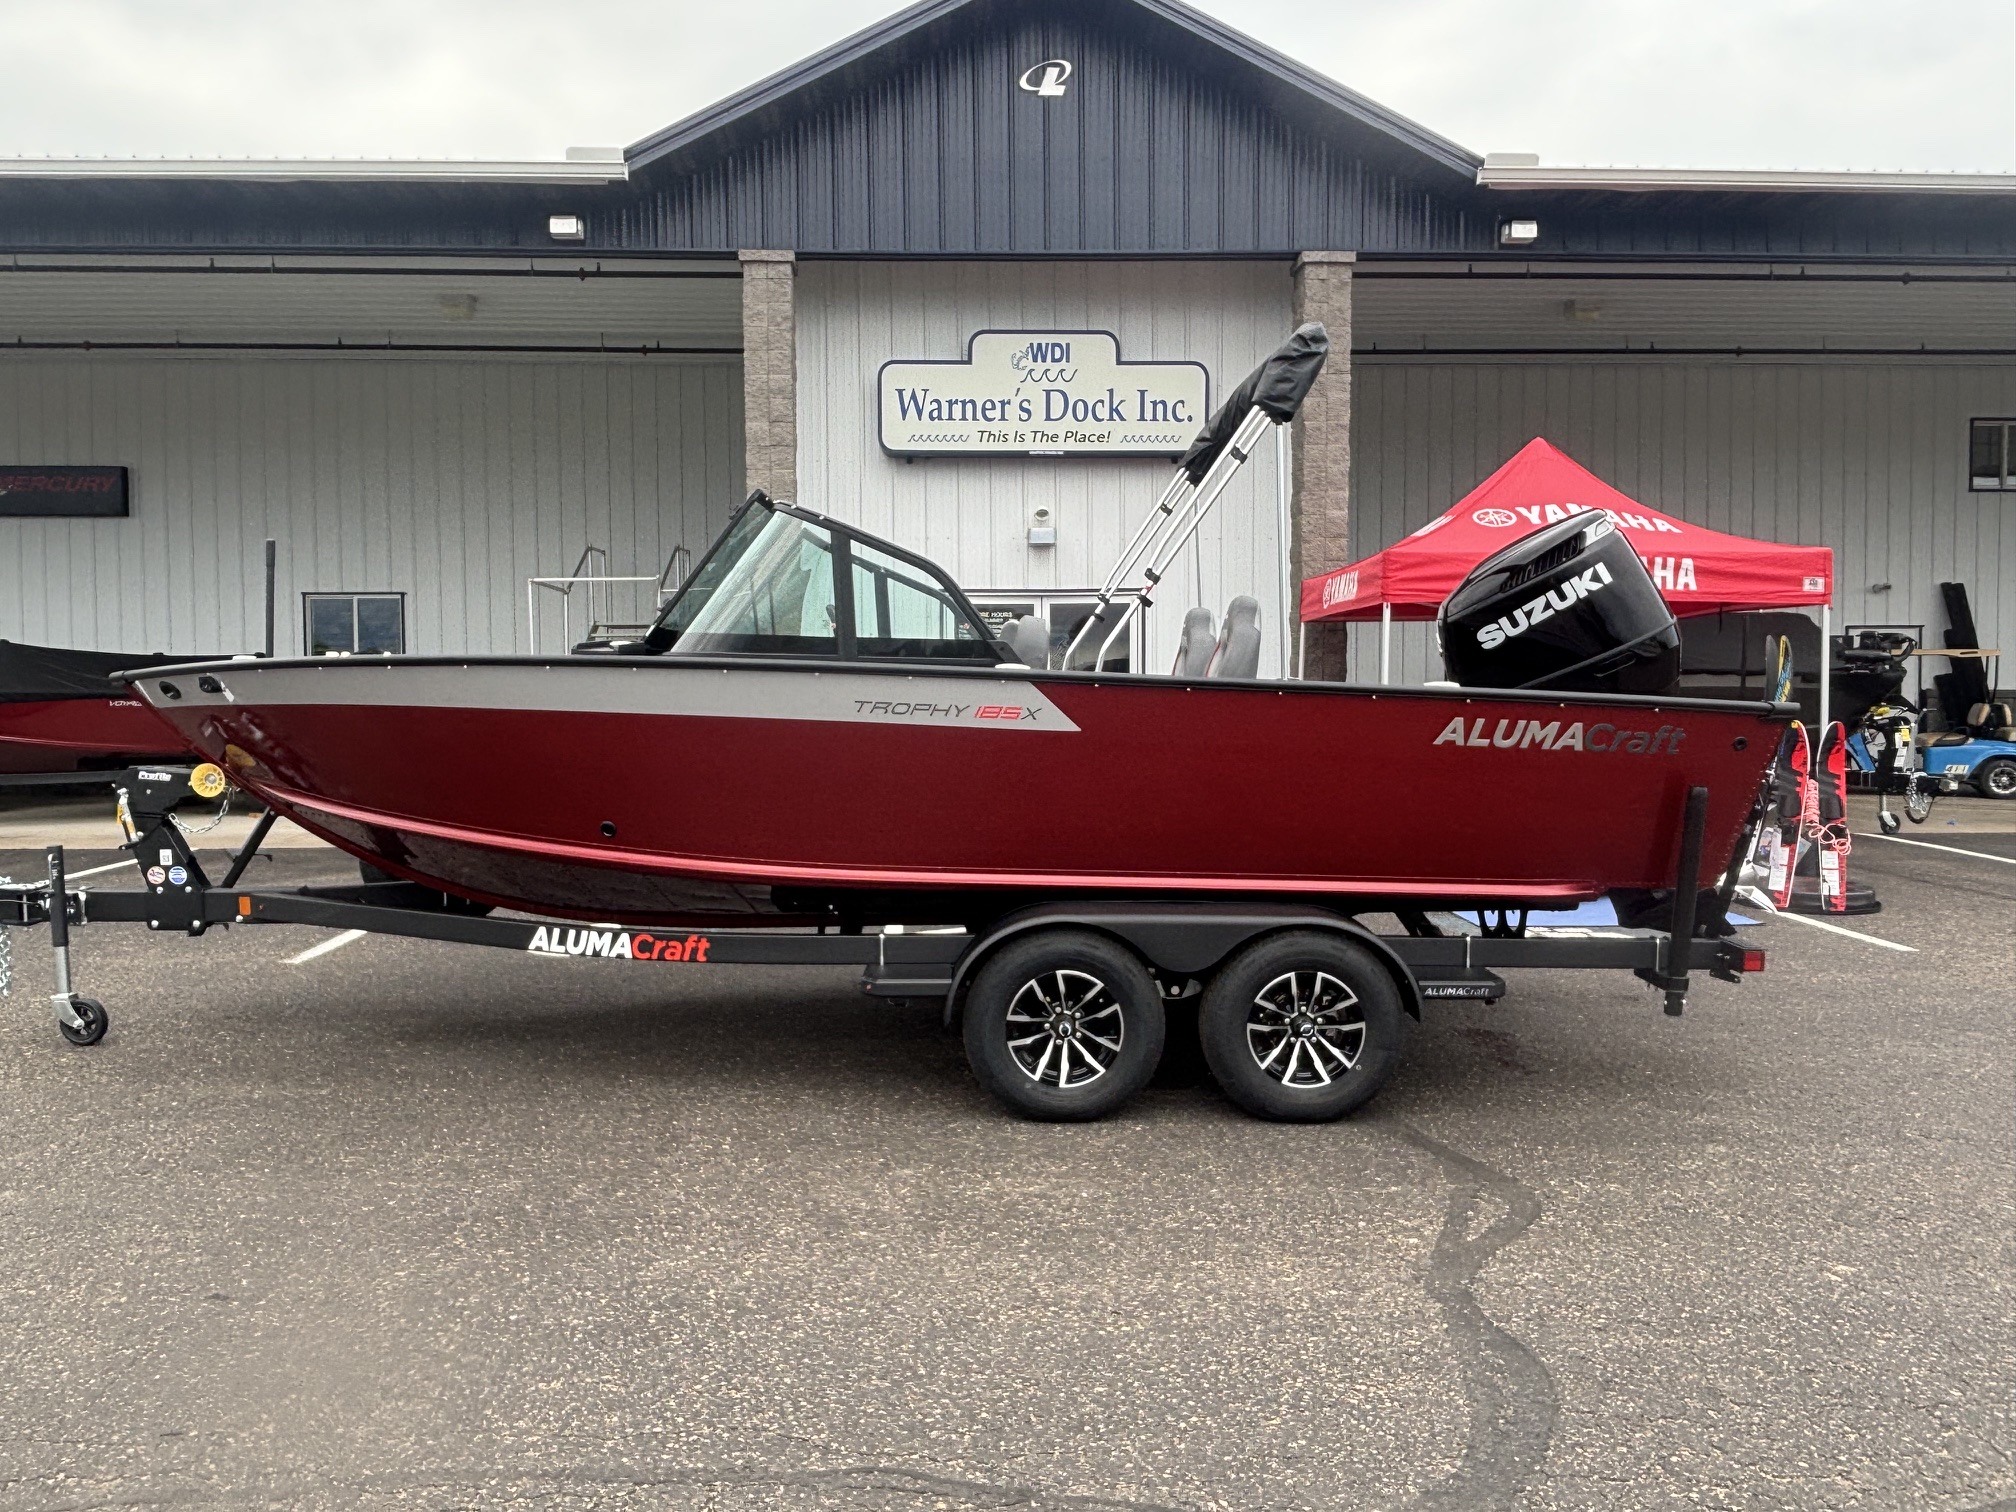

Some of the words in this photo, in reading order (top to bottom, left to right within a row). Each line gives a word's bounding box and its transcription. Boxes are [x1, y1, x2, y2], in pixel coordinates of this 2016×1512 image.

[1029, 342, 1071, 363] WDI
[895, 387, 1032, 422] Warner's
[1042, 388, 1127, 422] Dock
[1136, 389, 1193, 423] Inc.
[977, 430, 1011, 444] This
[1013, 430, 1026, 444] Is
[1030, 430, 1060, 444] The
[1063, 430, 1111, 444] Place!
[1476, 561, 1614, 650] SUZUKI
[854, 700, 971, 718] TROPHY
[1432, 716, 1687, 755] ALUMACraft
[528, 926, 711, 962] ALUMACraft
